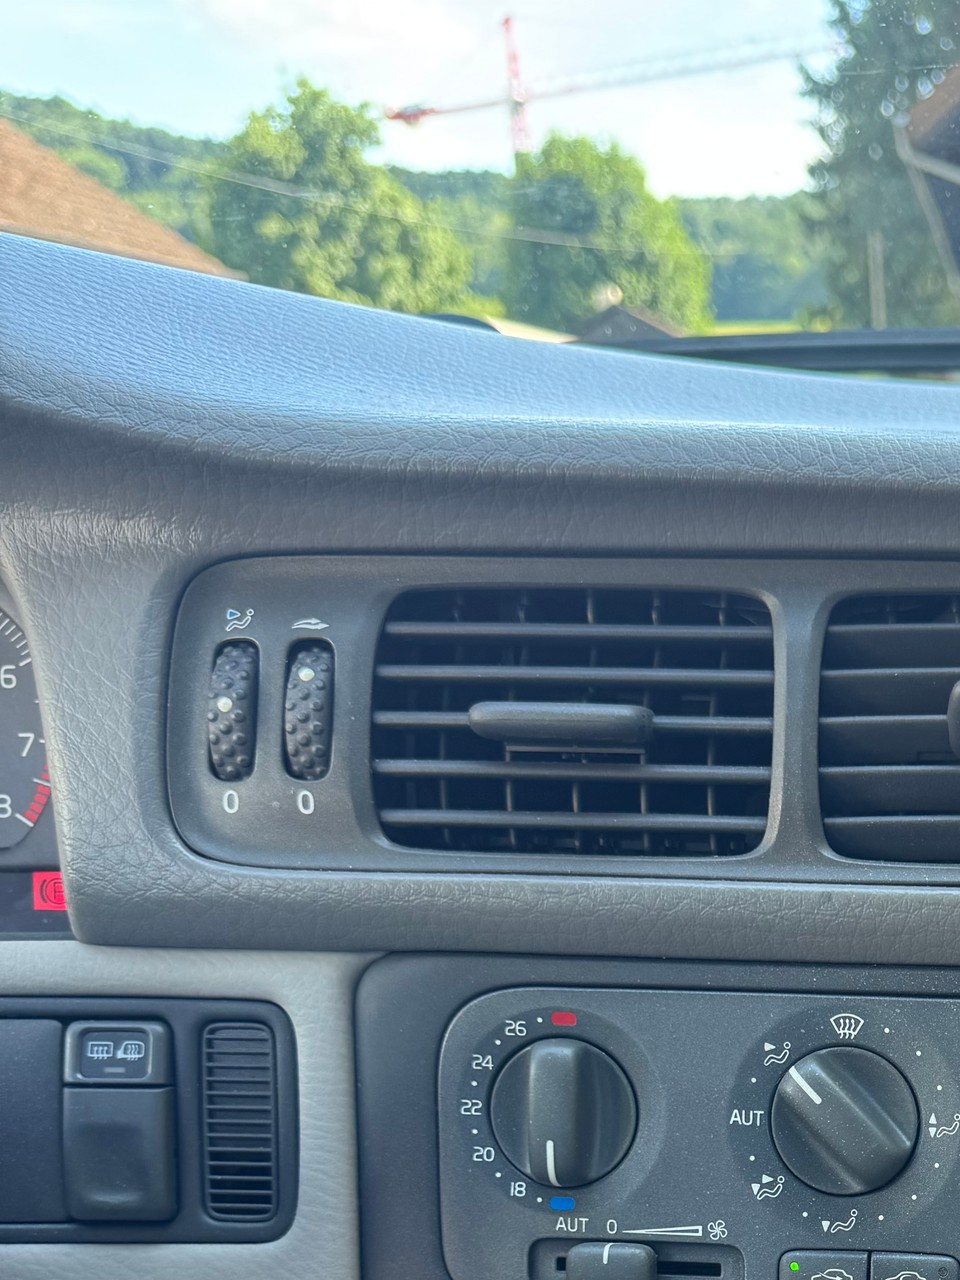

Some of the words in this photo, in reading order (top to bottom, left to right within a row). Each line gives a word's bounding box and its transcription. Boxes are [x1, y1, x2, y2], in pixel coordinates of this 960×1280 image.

[1, 665, 17, 689] 6
[18, 733, 35, 757] 7
[505, 1020, 527, 1037] 26
[472, 1054, 494, 1071] 24
[461, 1100, 482, 1116] 22
[729, 1109, 764, 1127] AUT
[472, 1146, 495, 1163] 20
[509, 1181, 526, 1197] 18
[555, 1217, 589, 1234] AUT
[606, 1219, 618, 1234] 0
